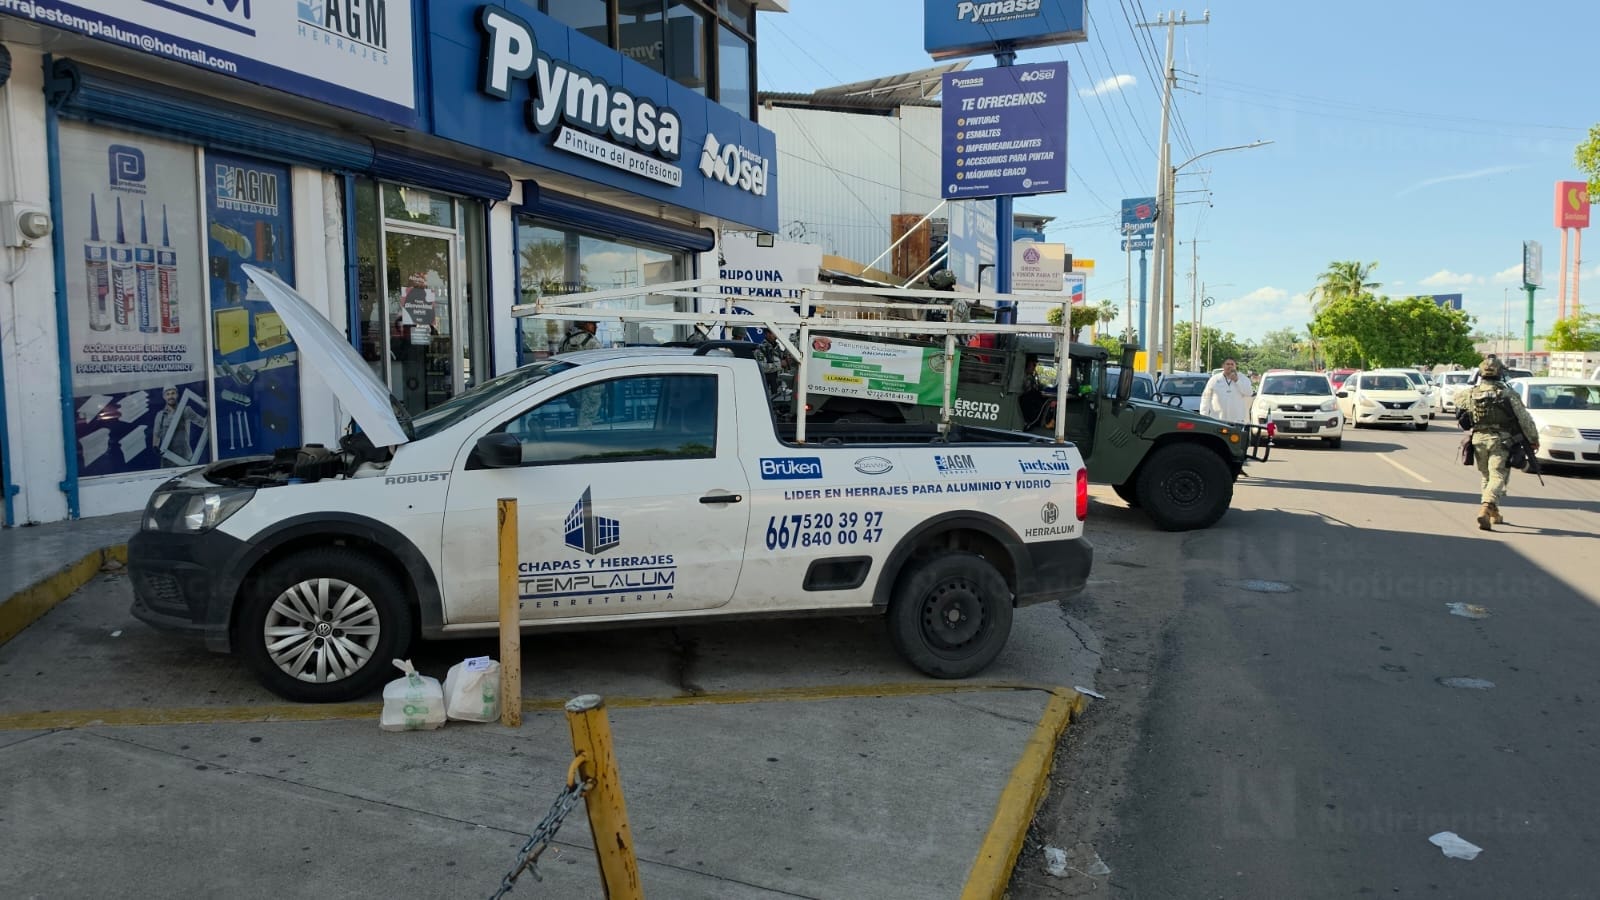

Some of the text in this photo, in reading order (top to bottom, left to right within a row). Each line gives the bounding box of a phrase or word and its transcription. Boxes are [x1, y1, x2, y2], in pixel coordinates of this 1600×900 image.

[957, 0, 1040, 22] Pymasa
[325, 0, 388, 49] AGM
[297, 26, 389, 65] HERRAJES
[487, 12, 680, 155] Pymasa
[952, 77, 984, 87] Pymasa
[1030, 69, 1056, 81] Osel
[962, 91, 1047, 111] TE OFRECEMOS:
[966, 115, 1000, 126] PINTURAS
[966, 129, 1001, 139] ESMALTES
[965, 139, 1042, 153] IMPERMEABILIZANTES
[565, 131, 680, 184] Pintura del profesional
[965, 152, 1055, 166] ACCESORIOS PARA PINTAR
[725, 142, 768, 197] Osel
[965, 167, 1027, 180] MÁQUINAS GRACO
[235, 168, 277, 206] AGM
[720, 269, 783, 282] RUPO UNA
[102, 354, 141, 362] EMPAQUE
[954, 397, 1000, 413] ÉRCITO
[762, 459, 821, 476] Brüken
[946, 454, 975, 469] AGM
[1018, 459, 1070, 472] jackson
[385, 473, 449, 485] ROBUST
[784, 479, 1051, 500] LIDER EN HERRAJES PARA ALUMINIO Y VIDRIO
[766, 511, 884, 550] 667 520 39 97
[802, 528, 883, 547] 840 00 47
[1025, 524, 1075, 537] HERRALUM
[518, 554, 675, 572] CHAPAS Y HERRAJES
[518, 571, 676, 593] TEMPLALUM
[519, 592, 674, 609] FERRETERIA
